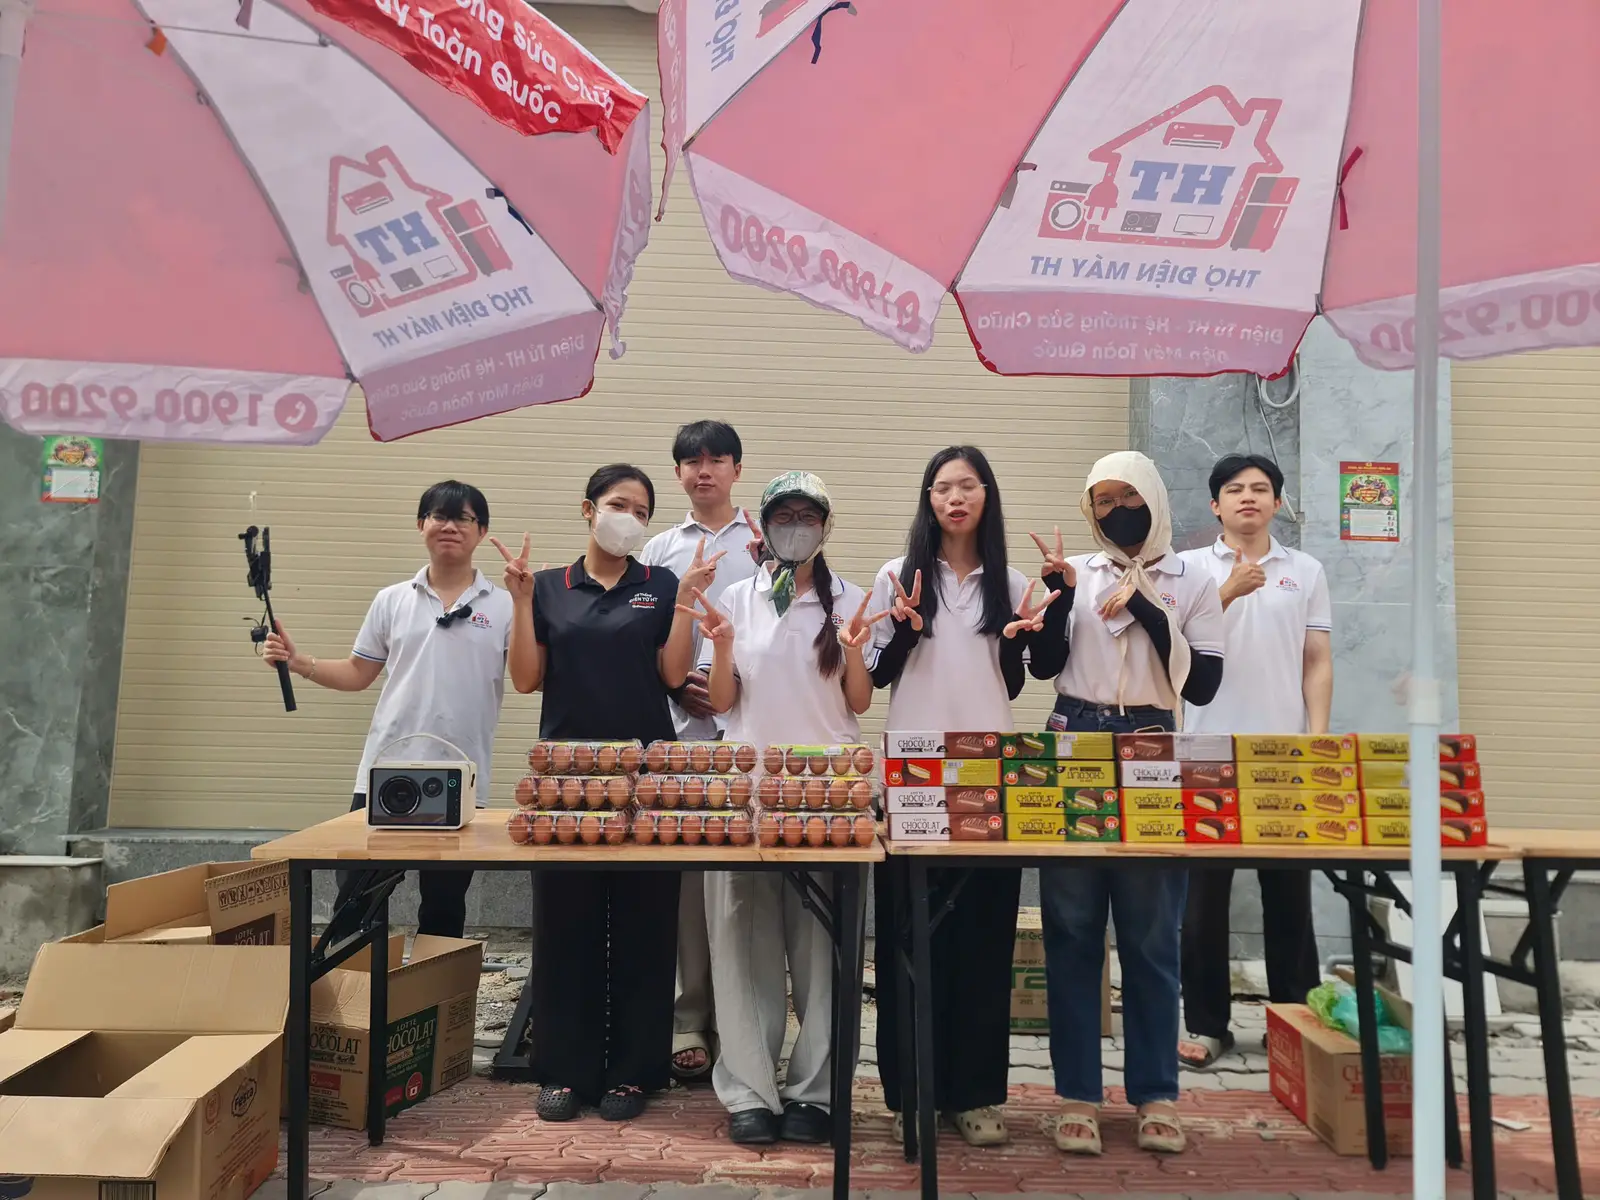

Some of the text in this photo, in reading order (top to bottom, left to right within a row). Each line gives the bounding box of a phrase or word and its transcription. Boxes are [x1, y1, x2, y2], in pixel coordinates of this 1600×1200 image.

[513, 21, 557, 75] Sửa
[418, 7, 482, 75] Toàn
[491, 61, 561, 124] Quốc
[897, 739, 936, 748] CHOCOLAT
[898, 794, 936, 803] CHOCOLAT
[901, 821, 941, 830] CHOCOLAT
[396, 1018, 417, 1032] LOTTE
